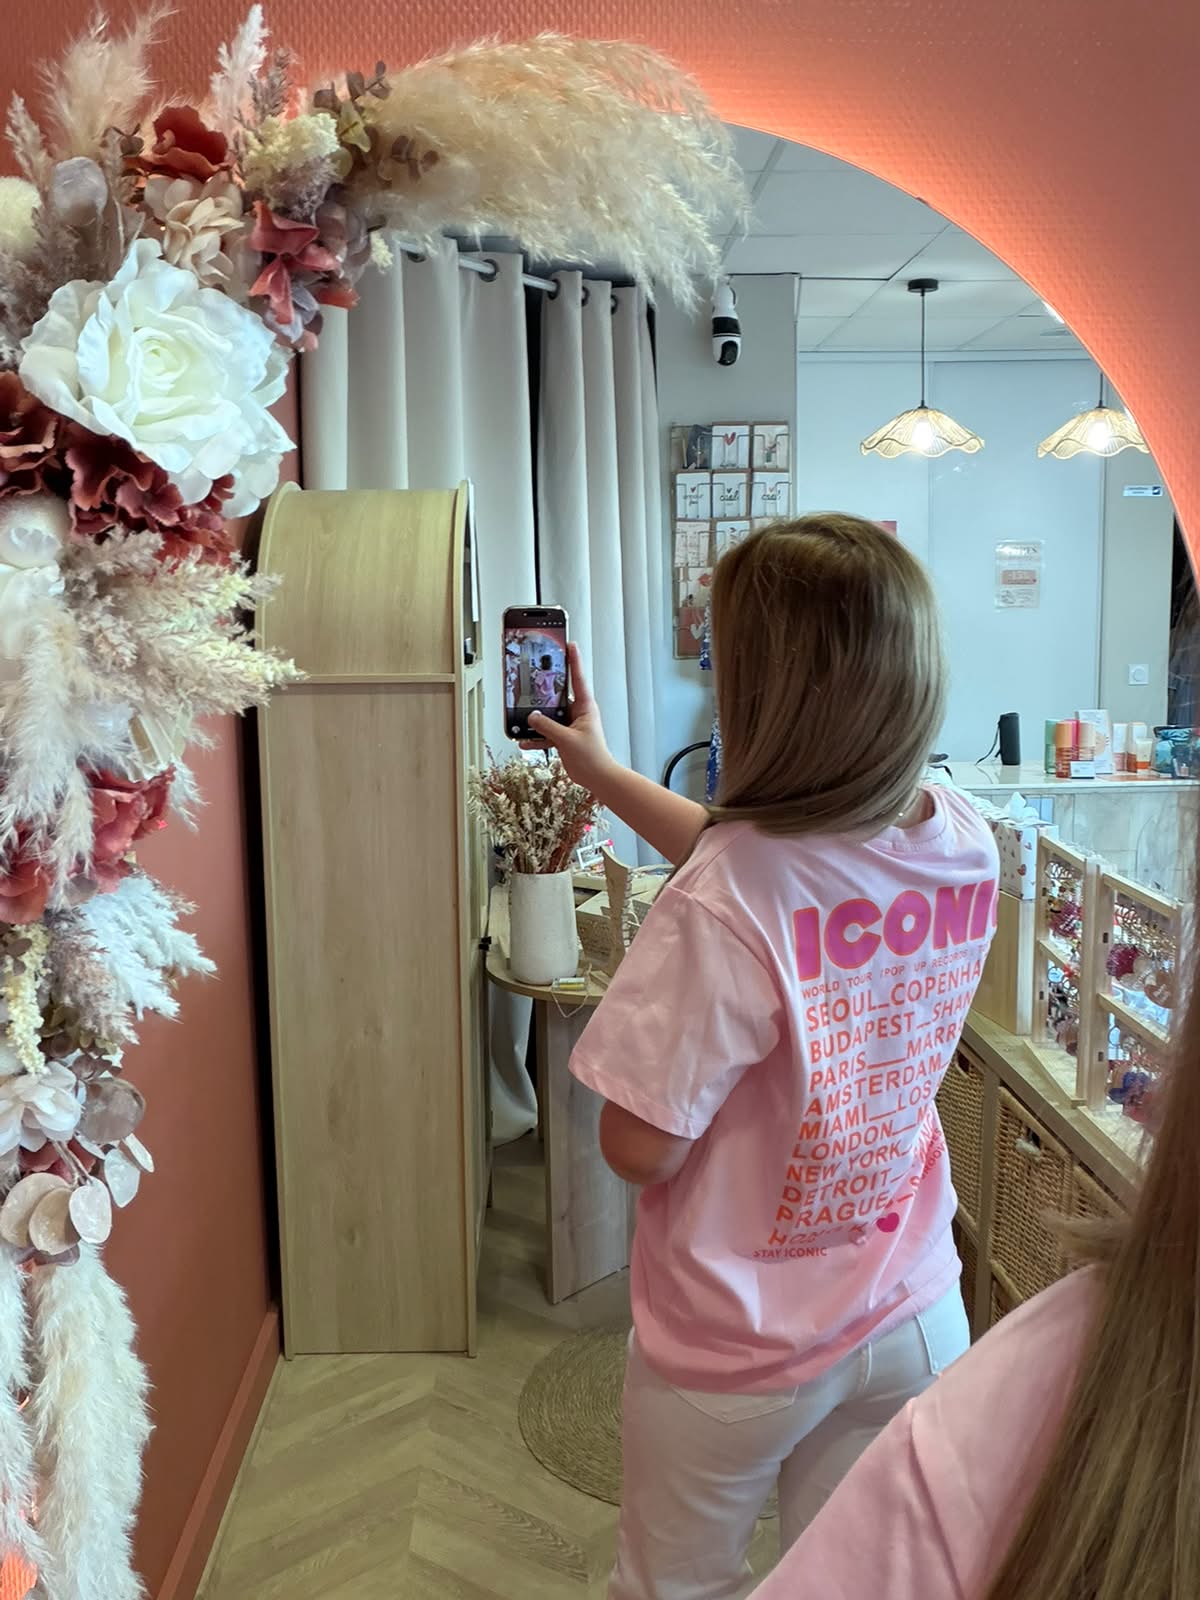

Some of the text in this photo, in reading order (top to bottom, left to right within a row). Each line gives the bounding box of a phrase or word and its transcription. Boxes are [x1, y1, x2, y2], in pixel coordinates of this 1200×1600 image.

[793, 879, 997, 982] ICONI
[802, 981, 840, 1000] WORLD
[847, 971, 873, 988] TOUR
[786, 1161, 841, 1184] NEW
[753, 1246, 828, 1258] STAY ICONIC
